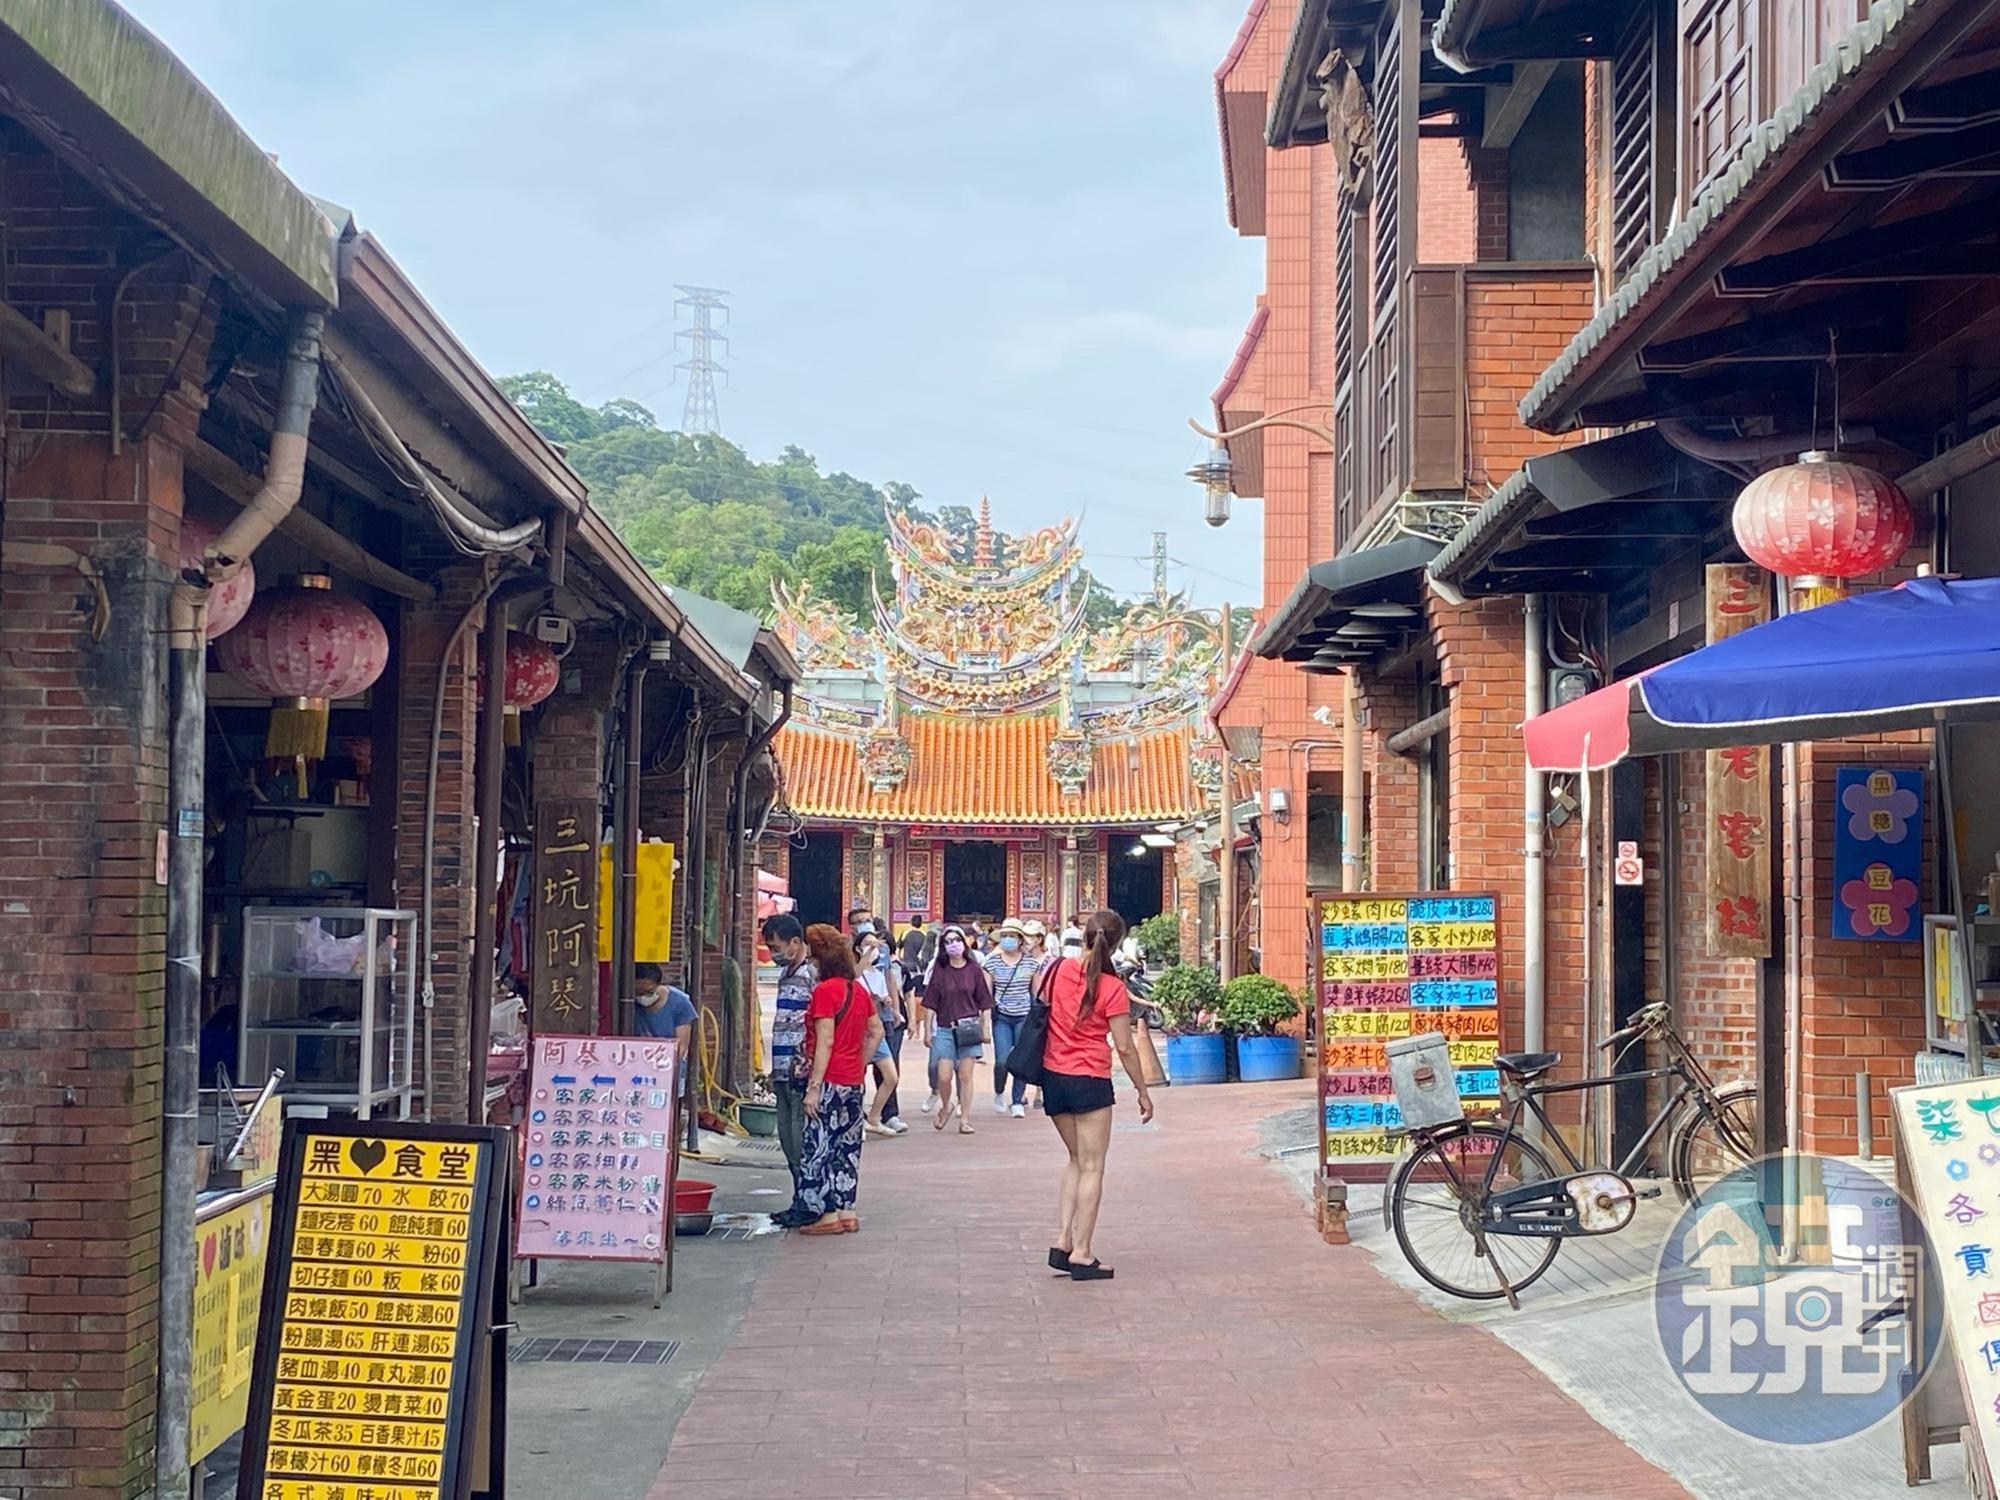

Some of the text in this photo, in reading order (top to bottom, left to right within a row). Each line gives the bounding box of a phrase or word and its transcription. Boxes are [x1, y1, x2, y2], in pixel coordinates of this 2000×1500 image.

[544, 818, 590, 1020] 三坑阿琴
[543, 1041, 670, 1070] 阿琴小吃
[1540, 1224, 1563, 1232] ARMY
